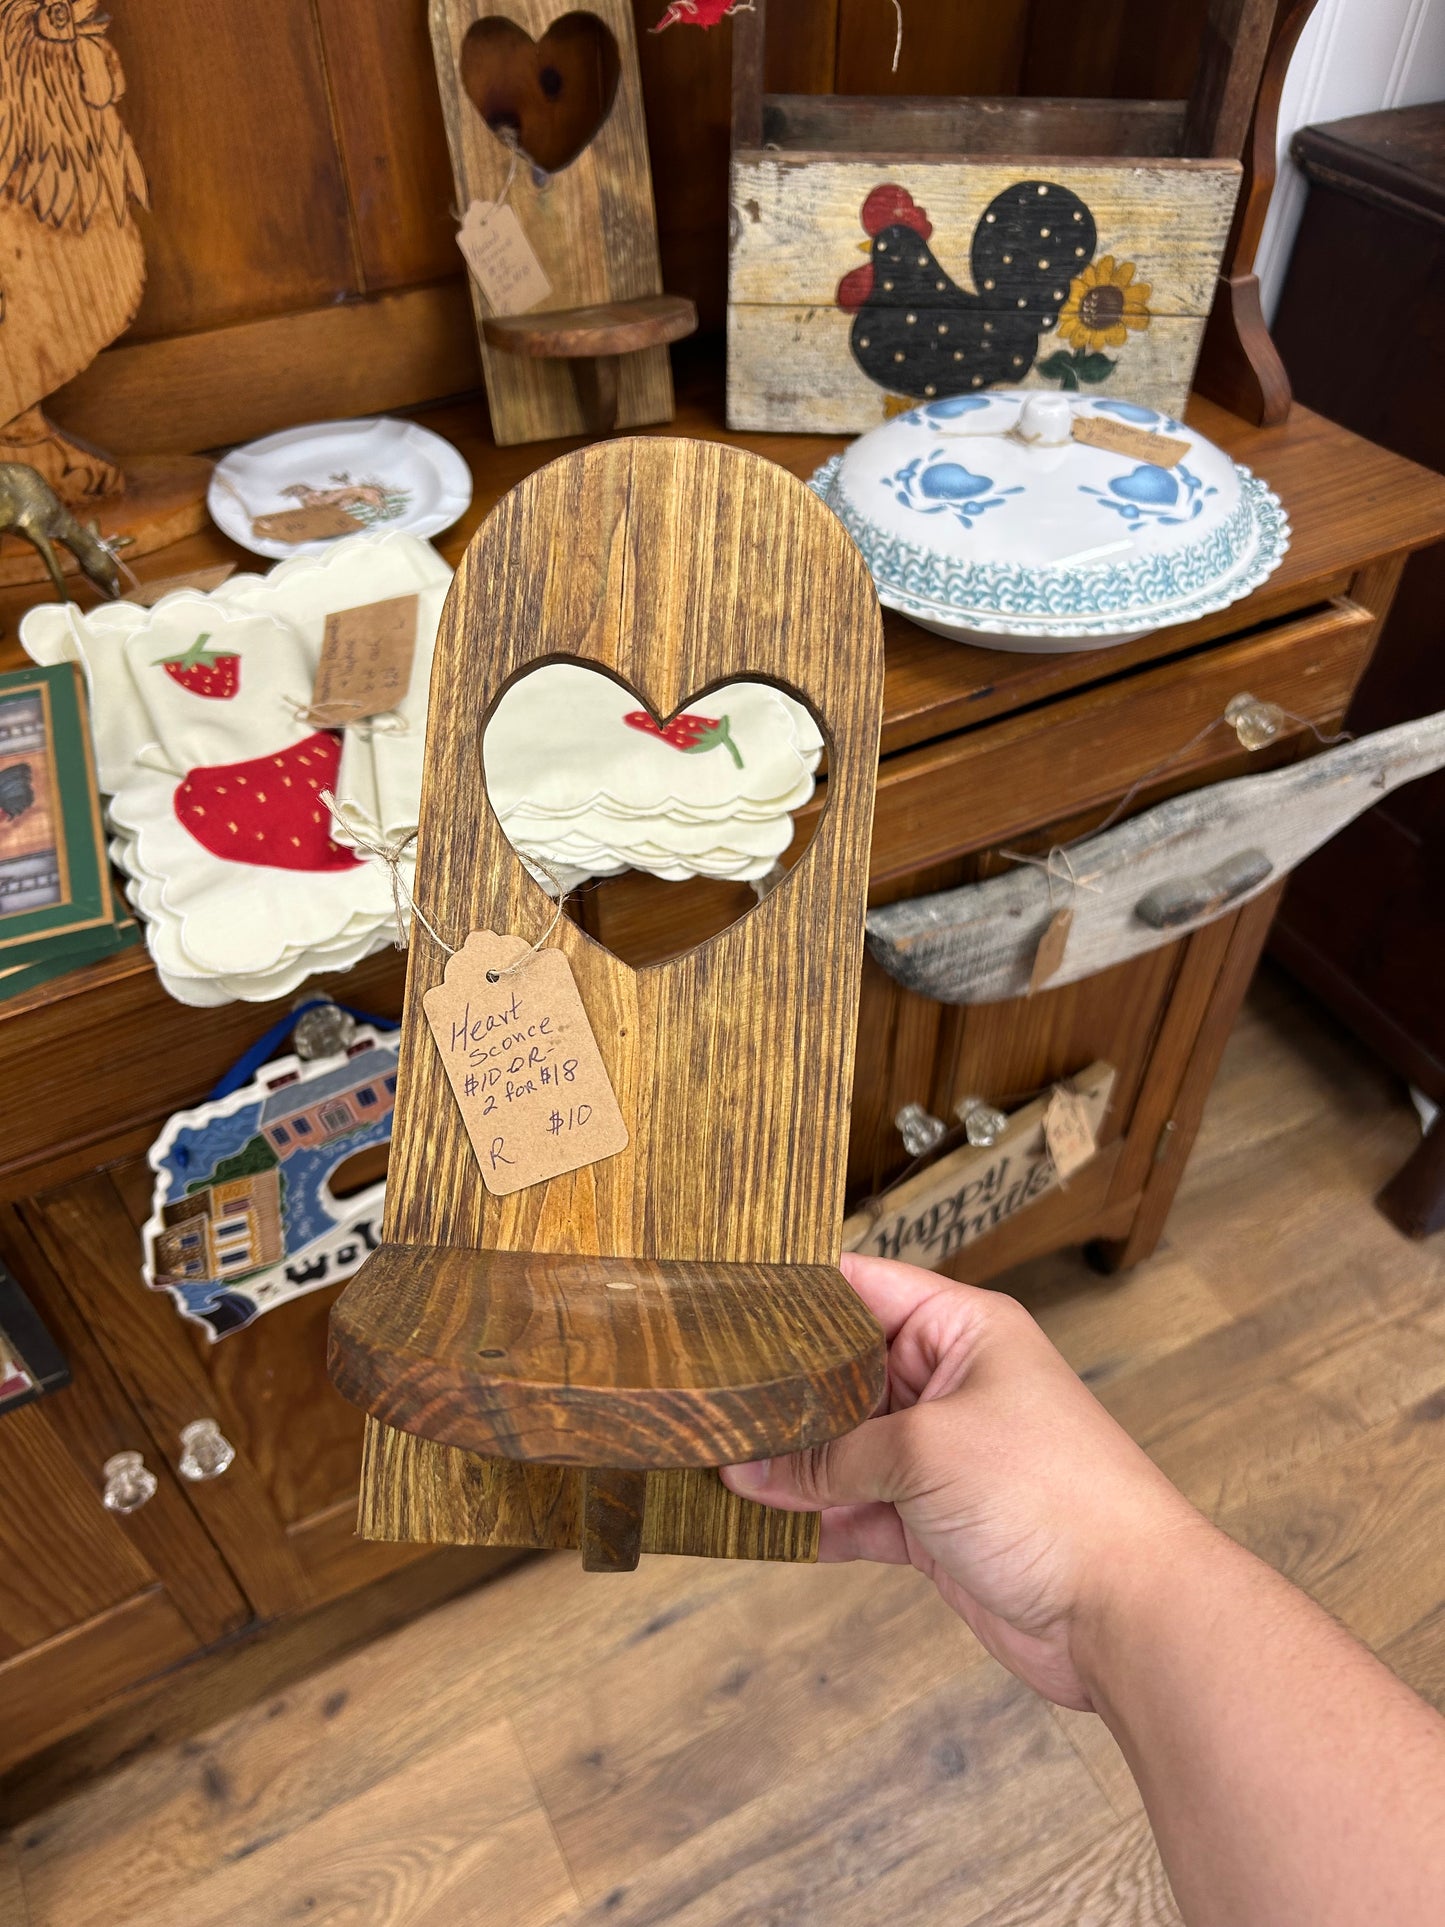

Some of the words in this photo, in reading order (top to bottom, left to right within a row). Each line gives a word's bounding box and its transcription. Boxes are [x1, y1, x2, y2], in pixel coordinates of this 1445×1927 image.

[451, 992, 523, 1053] Heart
[463, 1067, 501, 1097] $10
[482, 1095, 498, 1116] 2
[540, 1059, 579, 1086] $18
[546, 1104, 592, 1136] $10
[489, 1137, 515, 1170] R
[874, 1156, 1010, 1258] Happy
